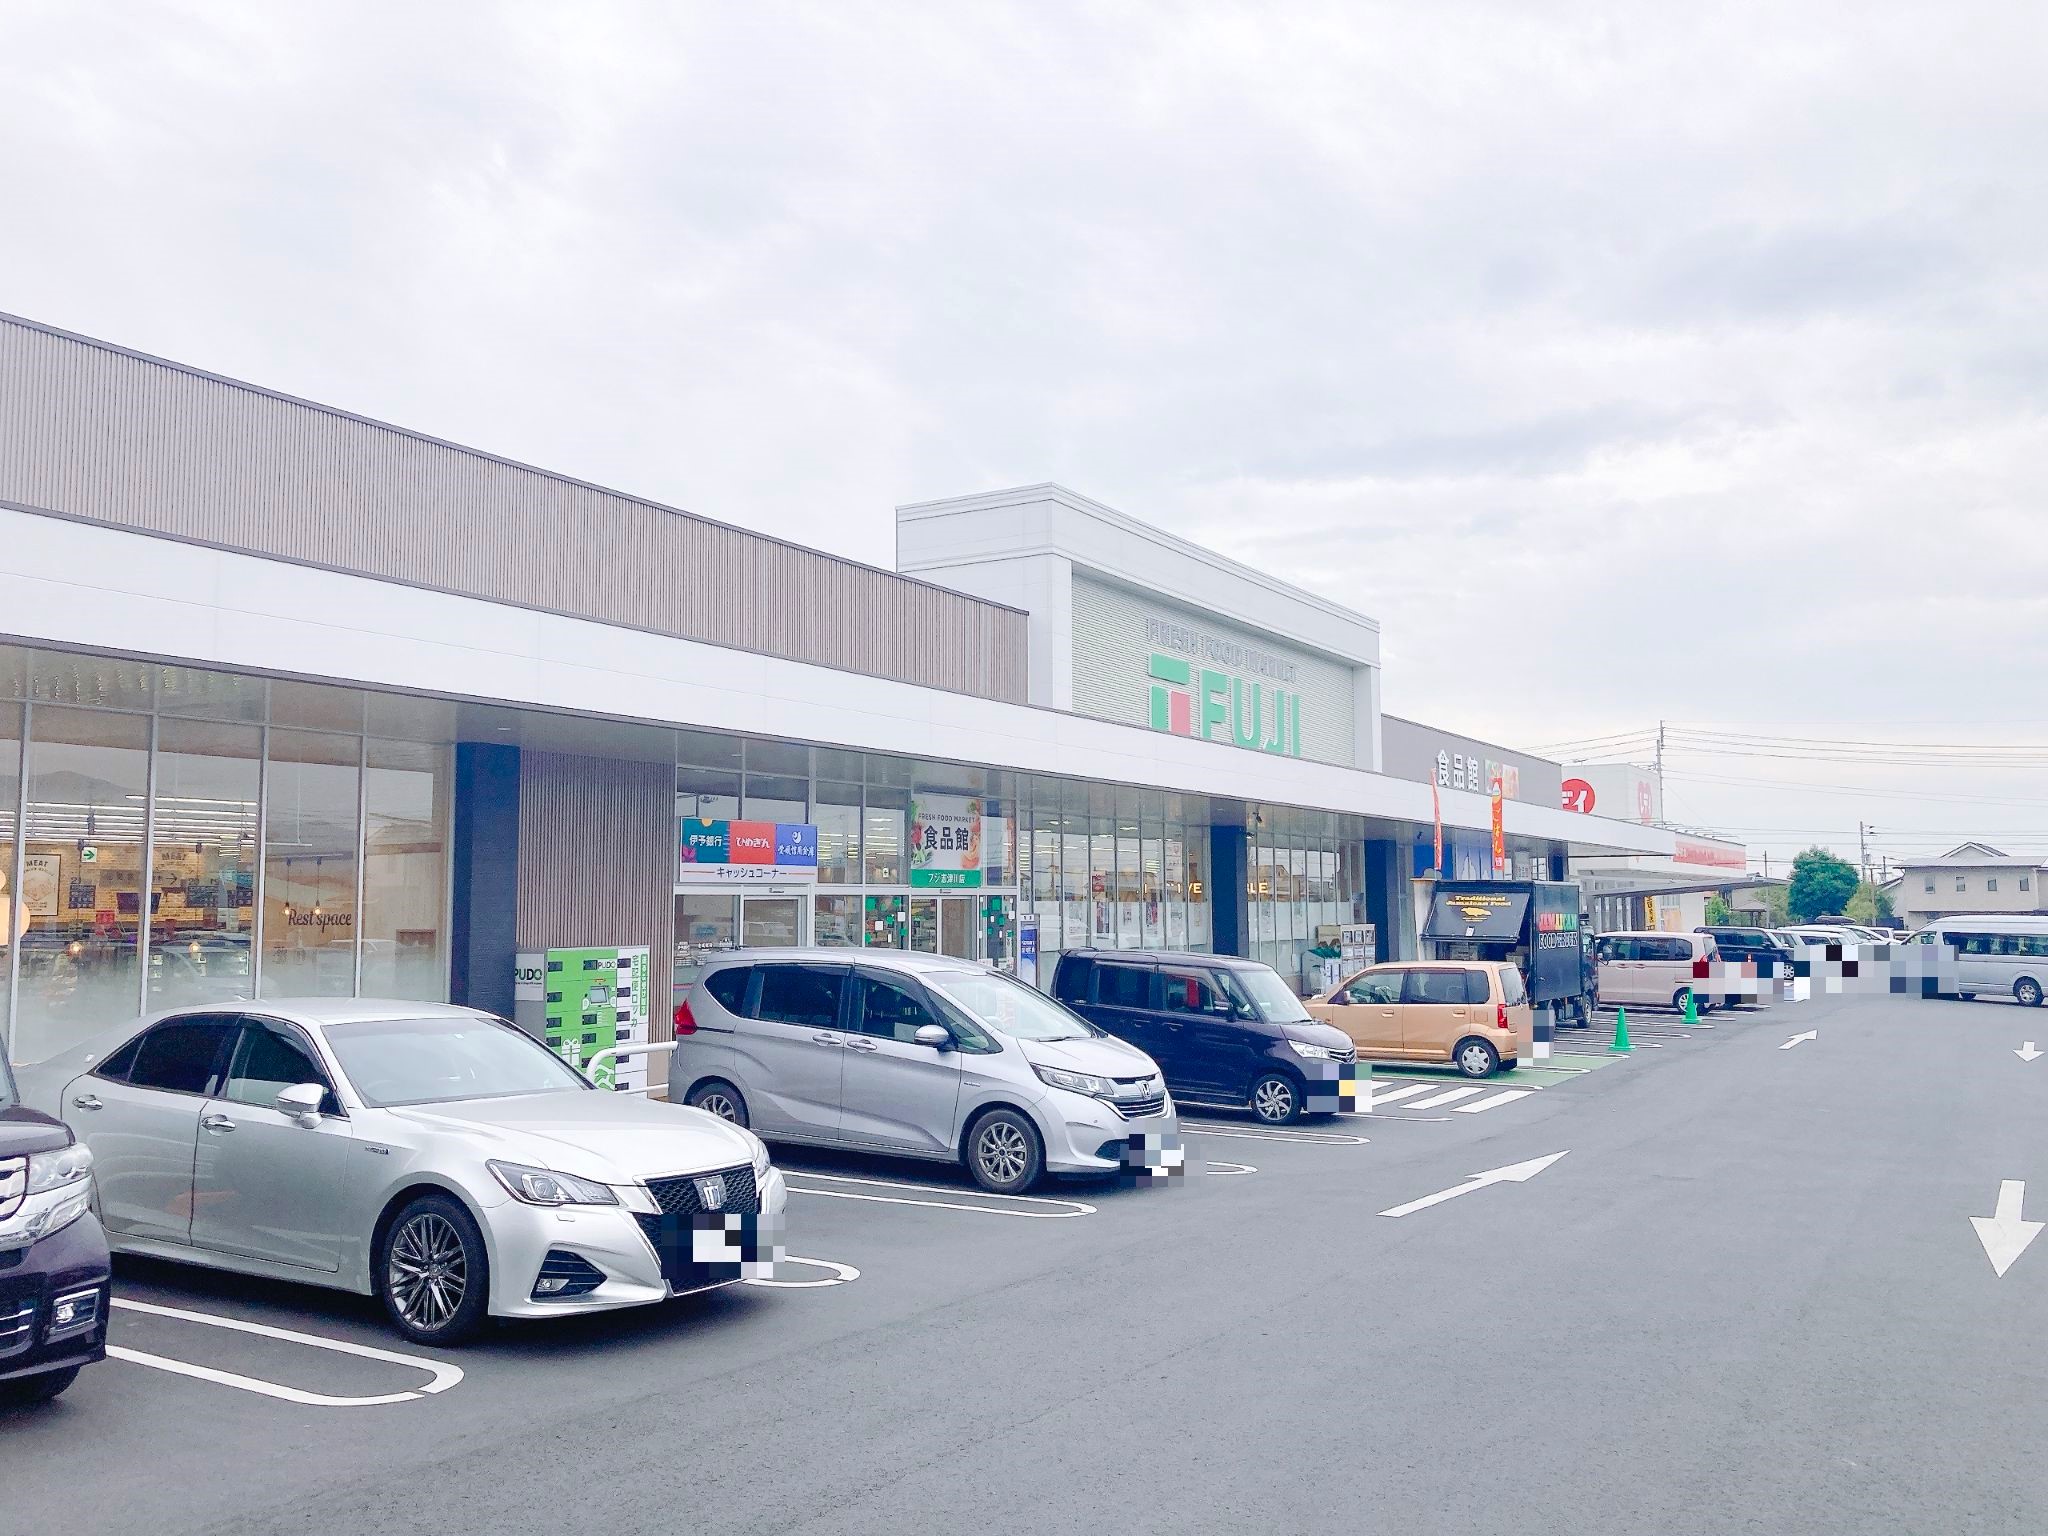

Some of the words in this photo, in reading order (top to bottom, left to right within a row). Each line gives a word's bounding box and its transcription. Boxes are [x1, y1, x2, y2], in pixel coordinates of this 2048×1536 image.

[1199, 668, 1301, 757] FUJI
[1438, 749, 1478, 793] 食品館
[918, 813, 936, 821] FRESH
[937, 814, 953, 822] FOOD
[954, 815, 975, 823] MARKET
[689, 834, 722, 847] 伊予銀行
[736, 837, 770, 849] ひめぎん
[924, 825, 969, 851] 食品館
[717, 867, 787, 879] キャッシュコーナー
[288, 909, 314, 926] Rest
[316, 913, 352, 933] space
[1539, 932, 1557, 949] FOOD
[598, 961, 616, 969] PUDO
[515, 968, 543, 981] PUDO
